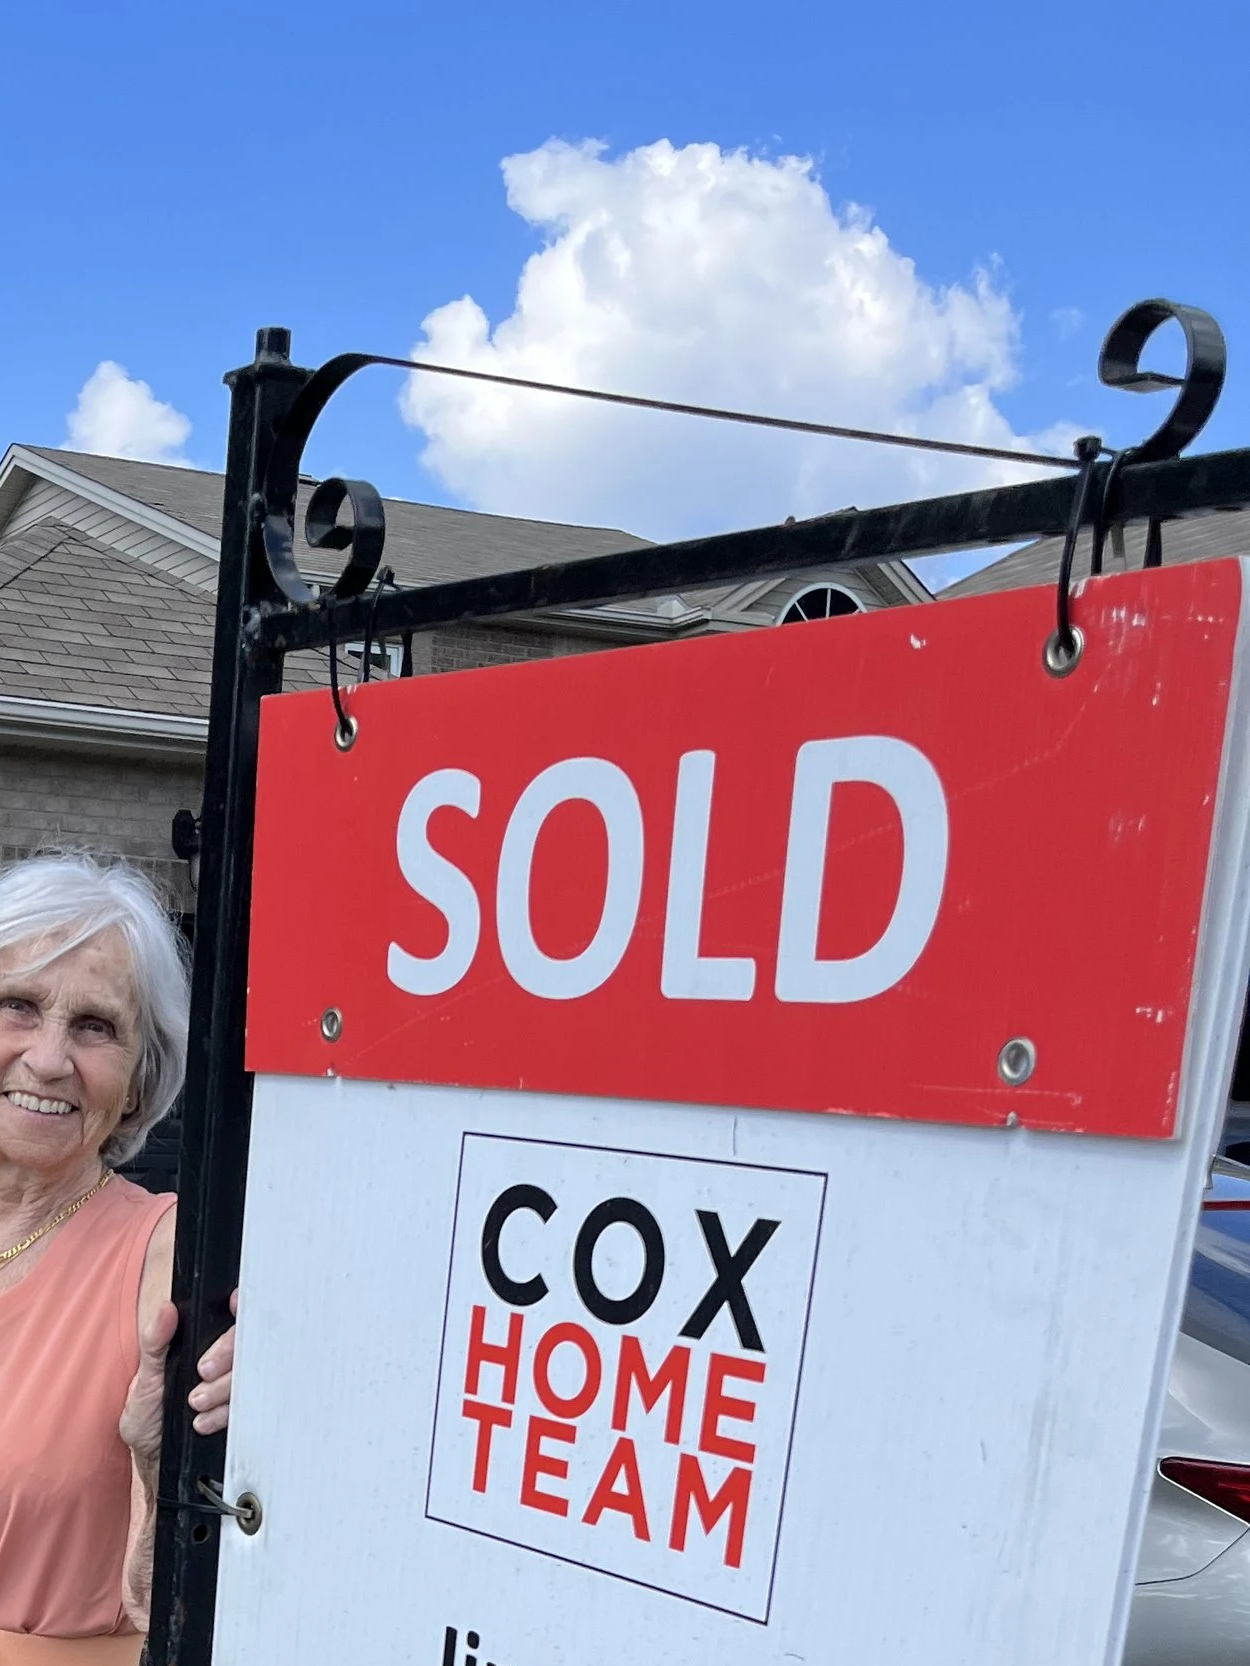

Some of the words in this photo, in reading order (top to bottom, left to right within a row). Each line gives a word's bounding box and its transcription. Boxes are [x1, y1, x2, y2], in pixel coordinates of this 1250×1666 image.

[386, 734, 949, 1004] SOLD
[480, 1183, 782, 1354] COX
[464, 1304, 767, 1465] HOME
[461, 1398, 753, 1569] TEAM
